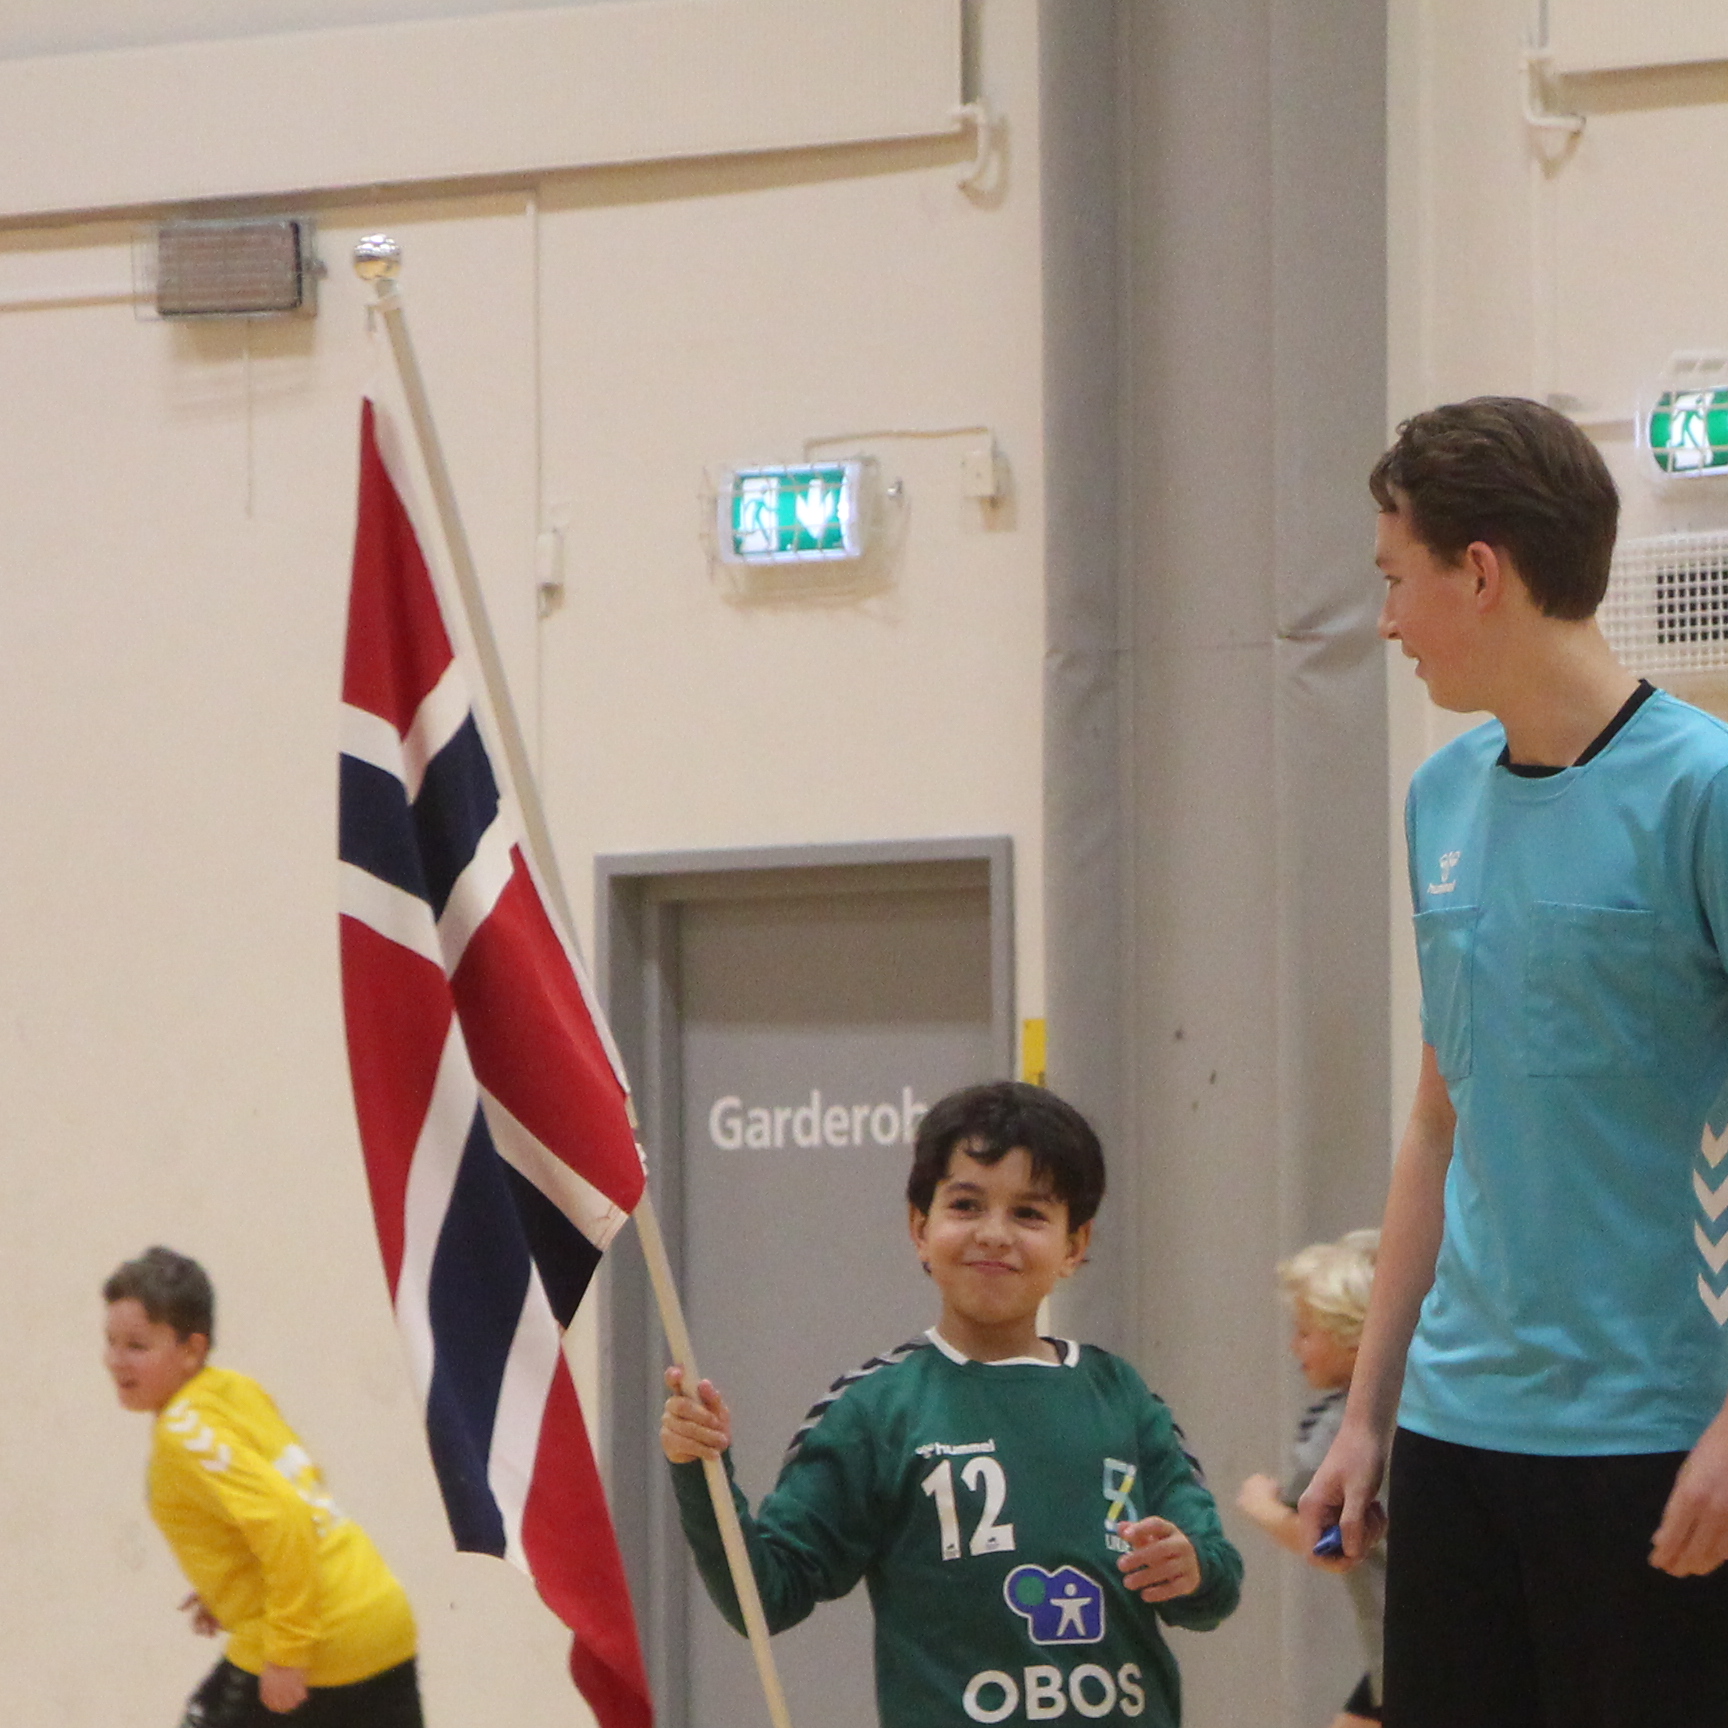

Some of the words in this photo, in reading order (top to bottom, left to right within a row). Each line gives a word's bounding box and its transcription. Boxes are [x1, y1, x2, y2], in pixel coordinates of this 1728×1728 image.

[709, 1087, 930, 1150] Garderob
[920, 1457, 1016, 1561] 12
[962, 1663, 1146, 1724] OBOS
